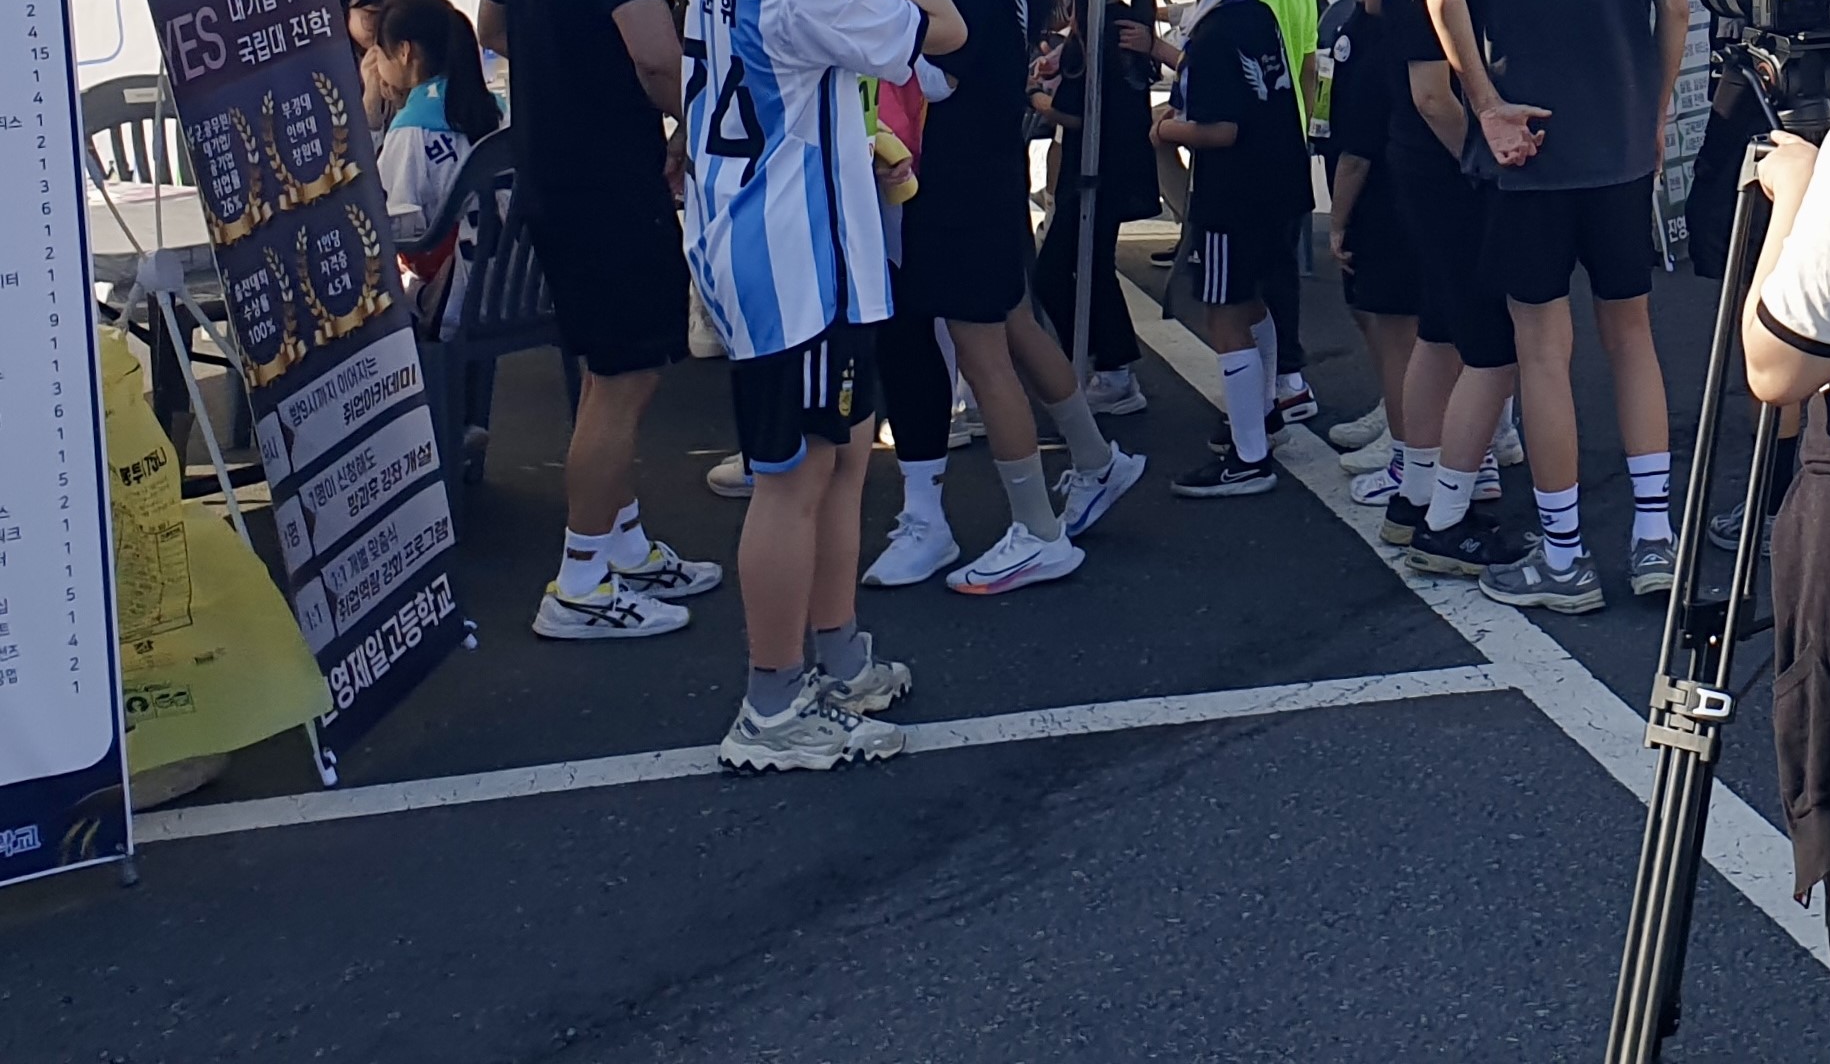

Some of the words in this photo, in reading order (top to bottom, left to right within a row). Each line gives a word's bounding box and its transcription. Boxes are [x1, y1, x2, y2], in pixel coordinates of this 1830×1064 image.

[26, 4, 36, 18] 2
[28, 25, 38, 39] 4
[237, 23, 287, 65] 국립대
[289, 7, 332, 48] 진학
[161, 6, 227, 85] YES
[31, 47, 50, 61] 15
[32, 69, 41, 83] 1
[33, 91, 43, 105] 4
[281, 93, 312, 119] 부경대
[36, 113, 44, 127] 1
[286, 115, 317, 143] 인하대
[37, 135, 46, 149] 2
[424, 133, 459, 166] 박
[39, 158, 47, 171] 1
[40, 179, 50, 193] 3
[41, 202, 51, 216] 6
[220, 194, 243, 218] 26%
[44, 224, 52, 237] 1
[44, 246, 55, 261] 2
[47, 268, 55, 282] 1
[48, 291, 56, 304] 1
[49, 313, 59, 327] 9
[248, 317, 276, 345] 100%
[51, 336, 58, 350] 1
[52, 359, 60, 373] 1
[52, 381, 62, 396] 3
[342, 363, 417, 426] 취업아카데미
[54, 404, 64, 419] 6
[57, 427, 65, 441] 1
[58, 449, 66, 464] 1
[404, 440, 434, 476] 개설
[58, 472, 69, 487] 5
[59, 495, 70, 510] 2
[62, 518, 70, 532] 1
[64, 541, 72, 555] 1
[403, 515, 450, 570] 프로그램
[65, 564, 73, 578] 1
[66, 587, 76, 602] 5
[67, 610, 76, 625] 1
[68, 633, 79, 648] 4
[320, 572, 456, 729] 영제일고등학교
[69, 657, 80, 672] 2
[72, 680, 80, 695] 1
